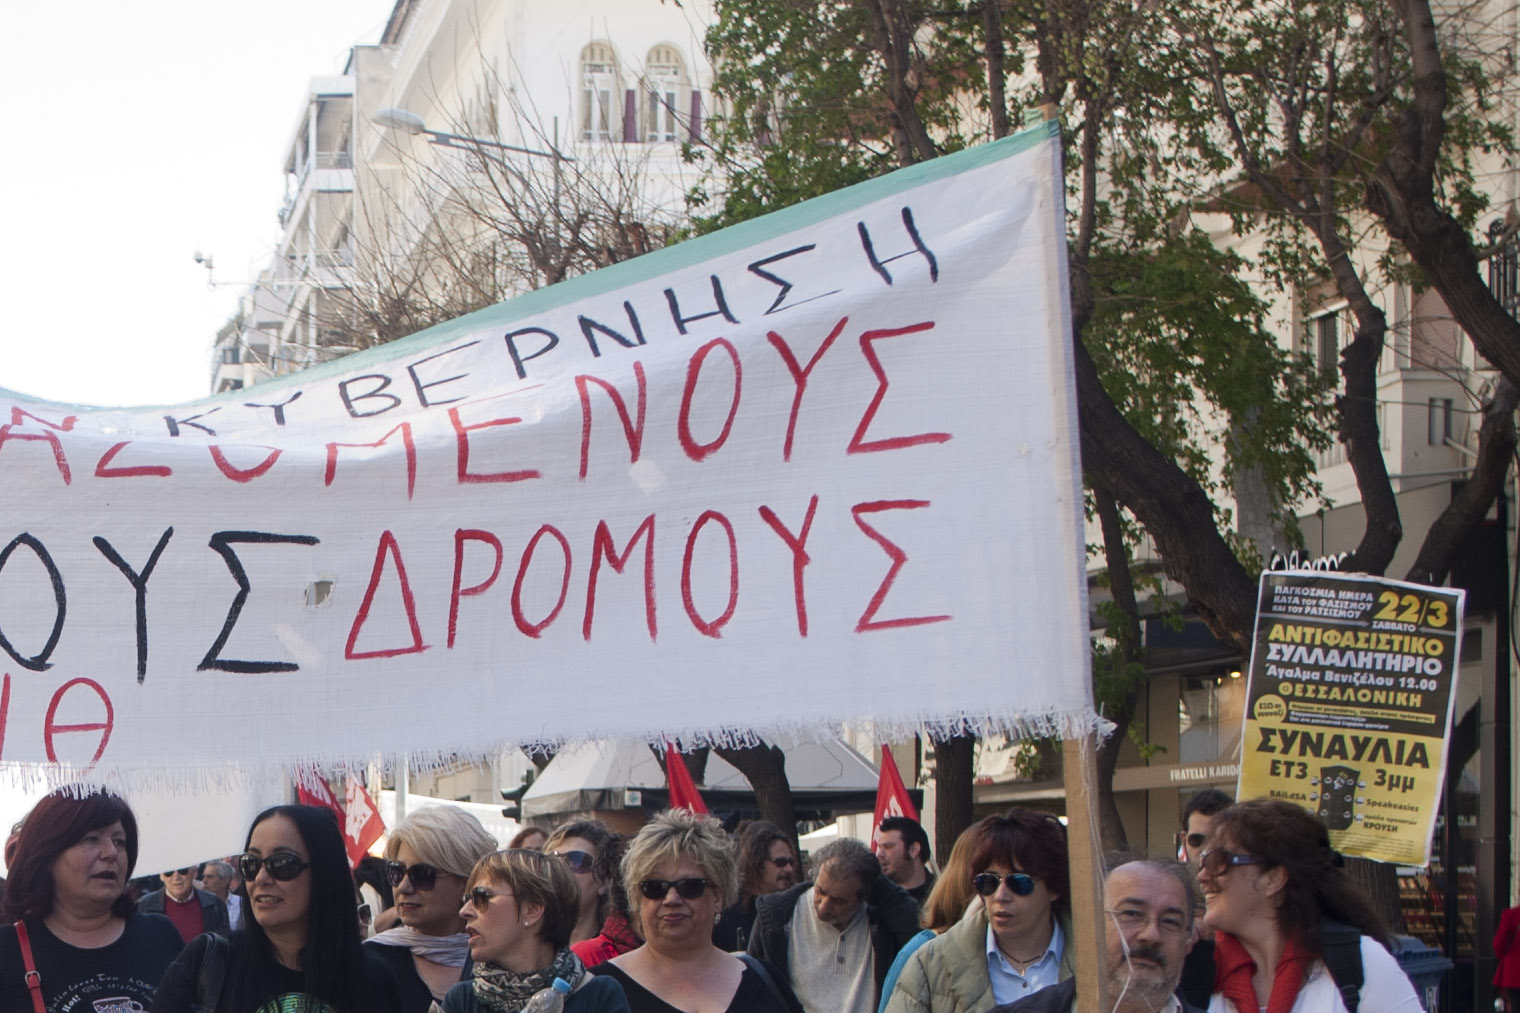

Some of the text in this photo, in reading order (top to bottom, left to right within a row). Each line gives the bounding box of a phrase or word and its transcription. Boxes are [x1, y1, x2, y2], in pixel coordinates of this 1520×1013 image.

[165, 203, 939, 437] ΚΥΒΕΡΝΗΣΗ
[345, 493, 955, 661] ΔΡΟΜΟΥΣ
[1273, 595, 1300, 605] ΚΑΤΑ
[1318, 598, 1373, 612] ΦΑΣΙΣΜΟΥ
[1274, 586, 1375, 602] ΠΑΓΚΟΣΜΙΑ ΗΜΕΡΑ
[1304, 606, 1362, 619] ΡΑΤΣΙΣΜΟΥ
[1374, 590, 1449, 628] 22/3
[1268, 623, 1444, 656] ΑΝΤΙΦΑΣΙΣΤΙΚΟ
[1371, 620, 1417, 633] ΣΑΒΒΑΤΟ
[1266, 643, 1443, 676] ΣΥΛΛΑΛΗΤΗΡΙΟ
[1265, 663, 1438, 692] Άγαλμα Βενιζέλου 12.00
[1278, 682, 1423, 708] ΘΕΣΣΑΛΟΝΙΚΗ
[1256, 727, 1430, 769] ΣΥΝΑΥΛΙΑ
[1270, 759, 1308, 780] ΕΤ3
[1374, 769, 1416, 793] 3μμ
